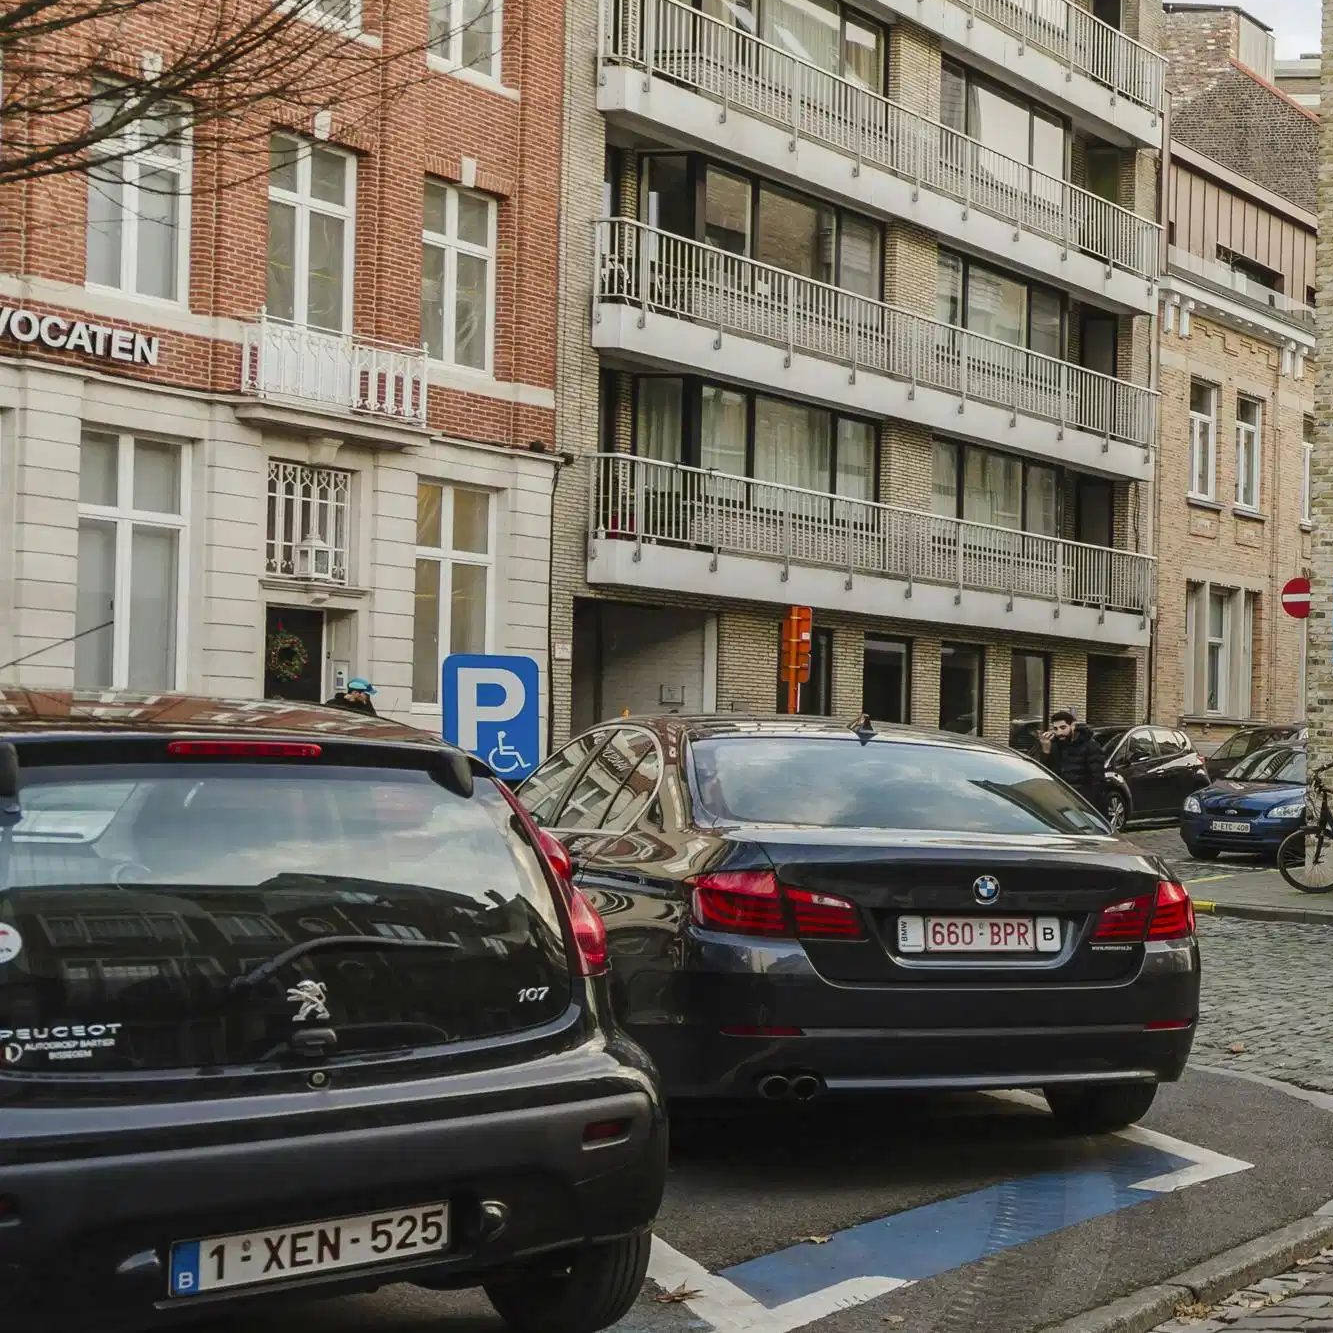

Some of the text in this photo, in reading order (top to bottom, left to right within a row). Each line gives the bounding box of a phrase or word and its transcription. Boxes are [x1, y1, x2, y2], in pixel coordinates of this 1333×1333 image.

[457, 666, 526, 752] P
[900, 920, 908, 942] BMW
[931, 921, 1030, 946] 660-BPR
[1042, 926, 1055, 942] B
[517, 986, 550, 1003] 107
[0, 1023, 122, 1041] PEUGEOT
[208, 1208, 445, 1281] 1-XEN-525
[178, 1271, 195, 1290] B
